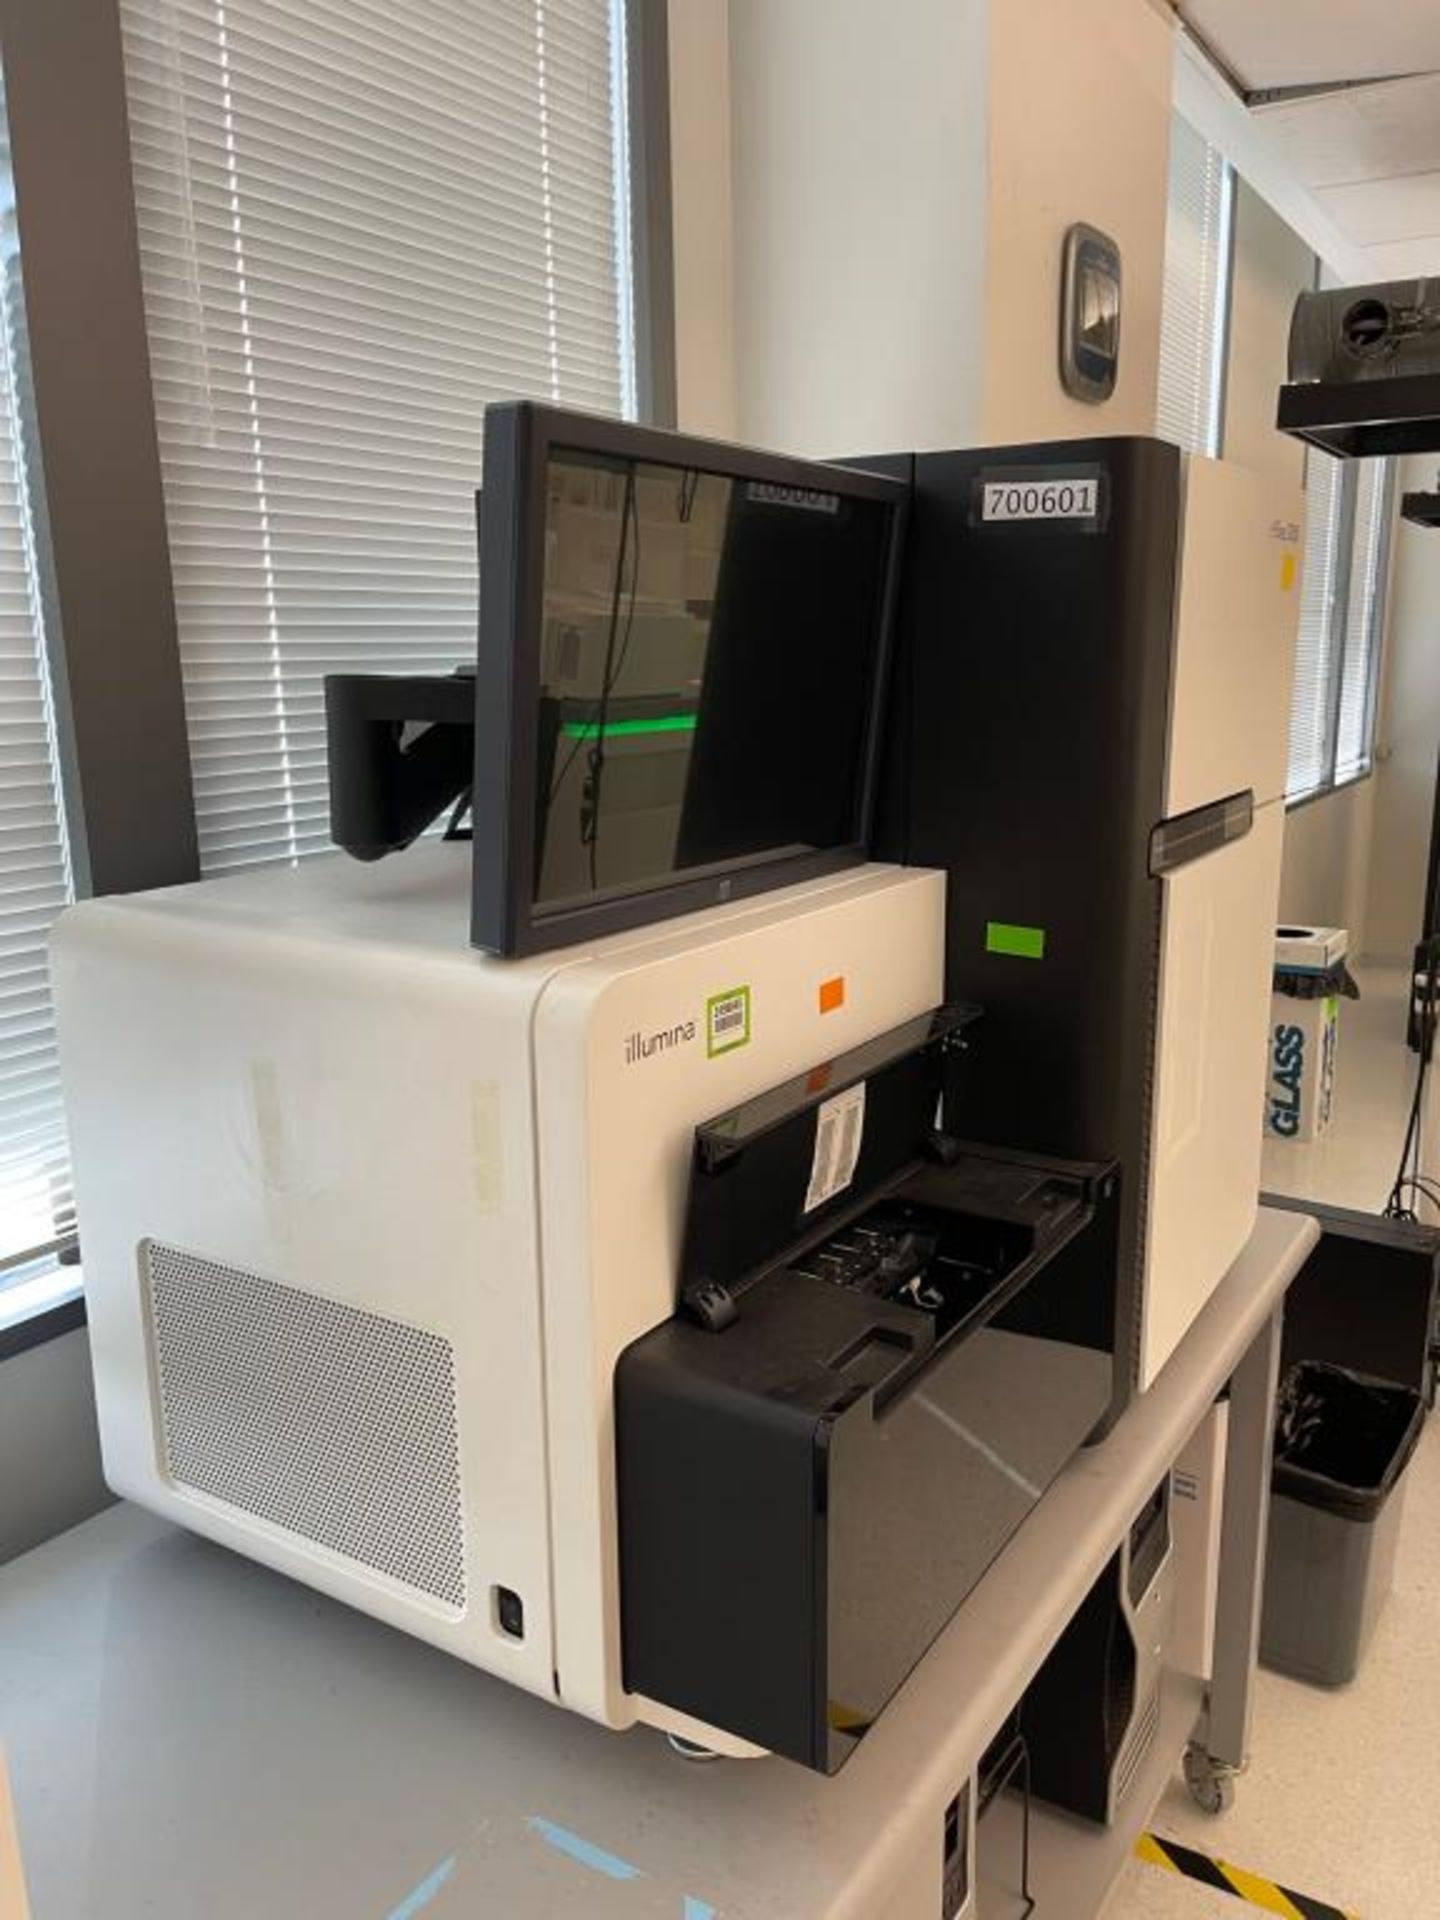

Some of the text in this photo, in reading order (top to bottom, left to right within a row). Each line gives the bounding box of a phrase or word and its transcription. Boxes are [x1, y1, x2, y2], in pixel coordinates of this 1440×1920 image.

[991, 486, 1093, 515] 700601
[625, 1021, 696, 1064] illumina
[1270, 1024, 1304, 1137] GLASS
